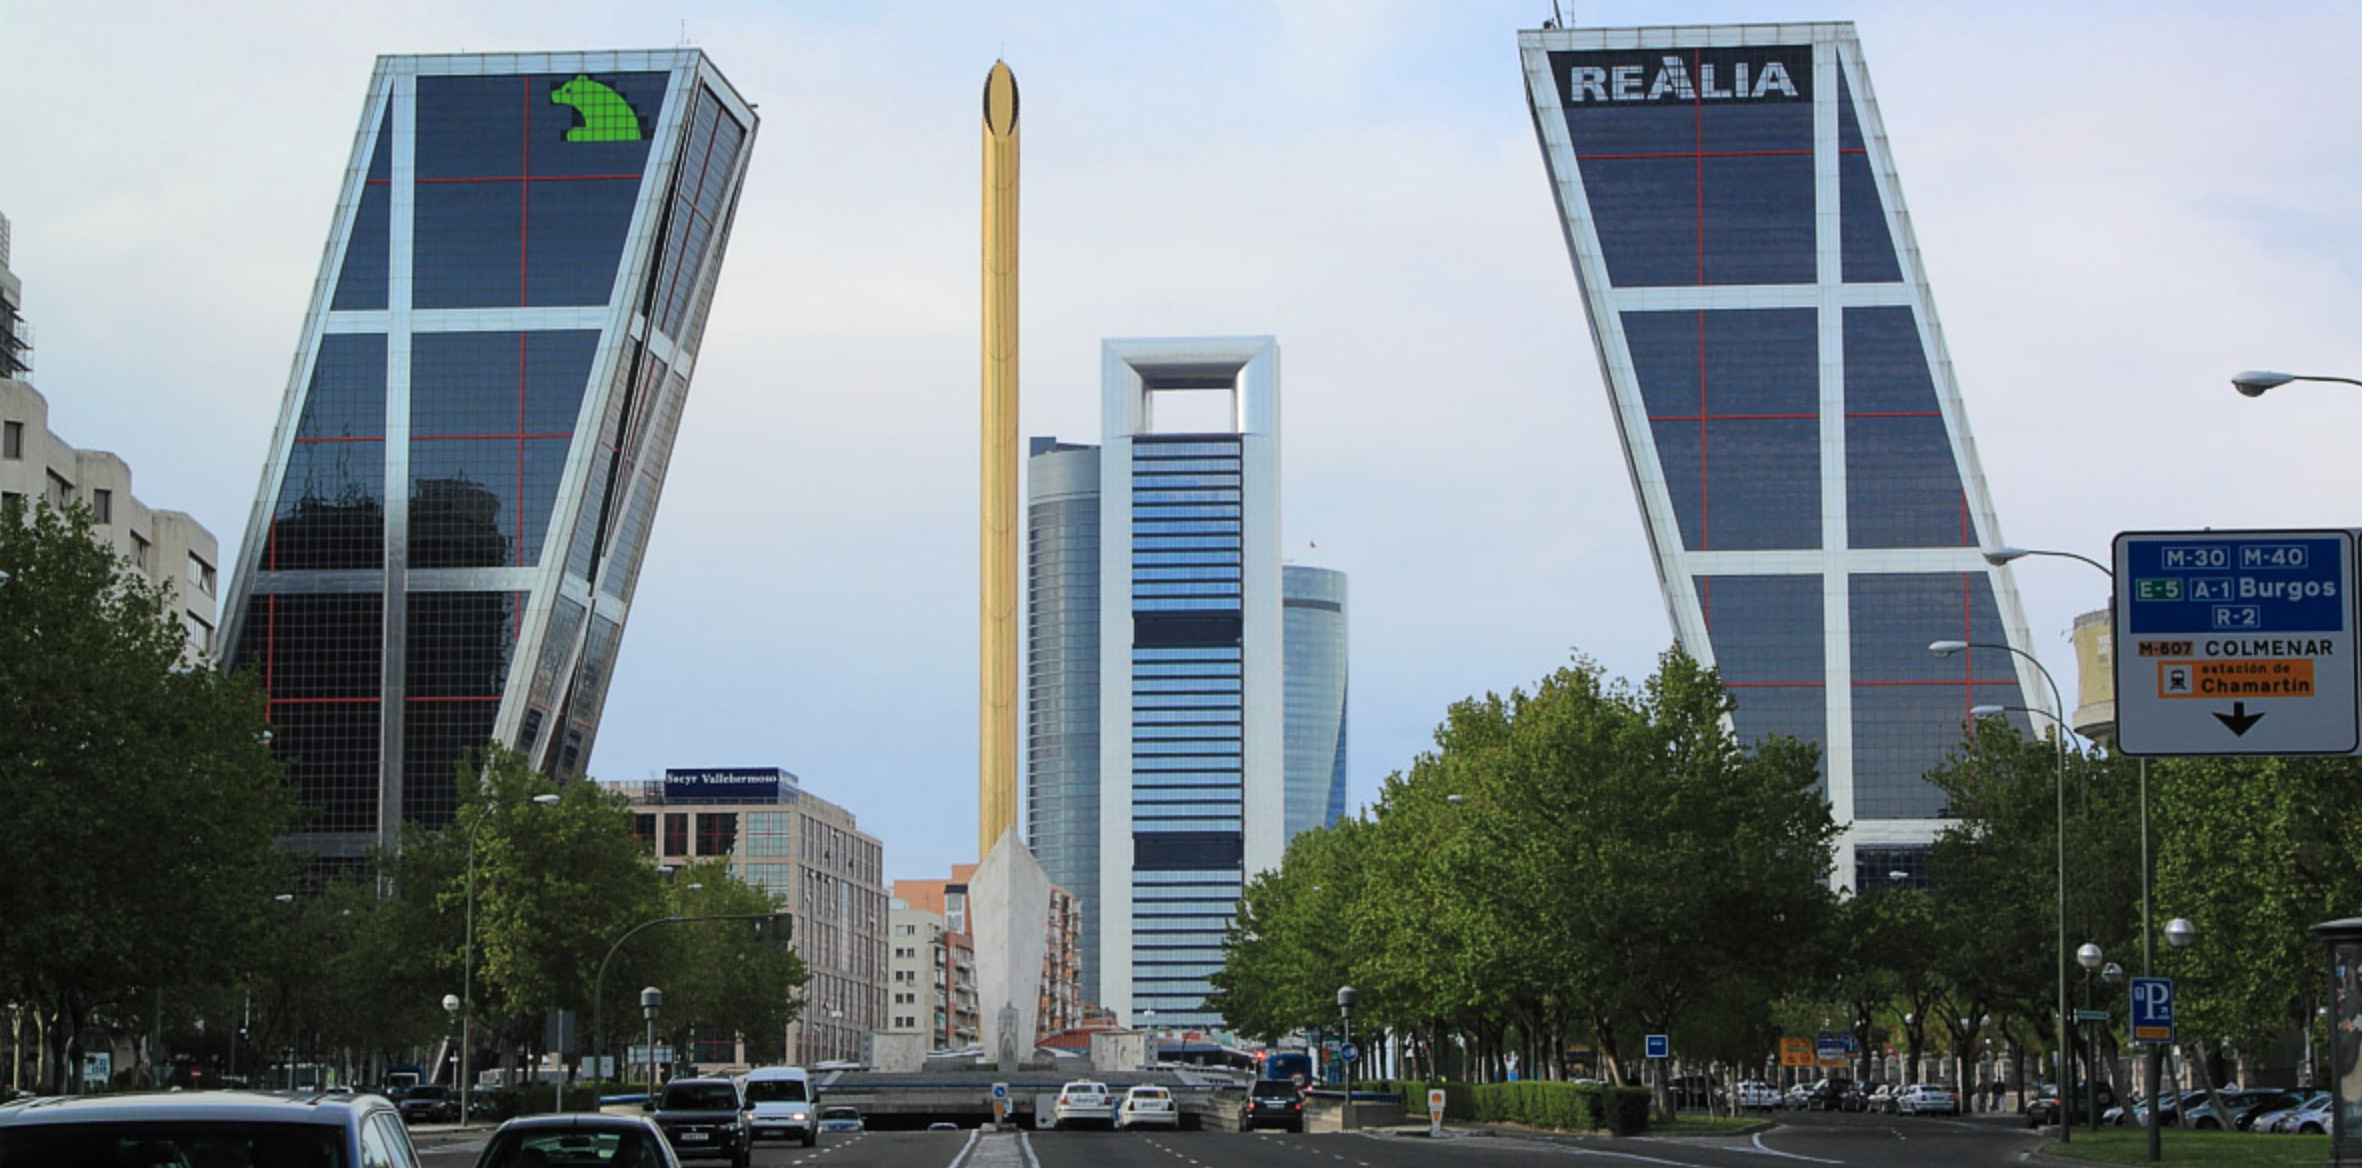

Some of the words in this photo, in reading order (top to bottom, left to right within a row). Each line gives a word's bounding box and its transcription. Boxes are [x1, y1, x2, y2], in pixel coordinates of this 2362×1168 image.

[1571, 56, 1798, 102] REALIA
[2166, 550, 2225, 566] M-30
[2244, 548, 2303, 565] M-40
[2139, 581, 2179, 598] E-5
[2195, 581, 2230, 598] A-1
[2239, 577, 2337, 601] Burgos
[2216, 608, 2256, 625] R-2
[2138, 642, 2193, 656] M-607
[2205, 640, 2334, 656] COLMENAR
[2201, 663, 2267, 674] estación
[2273, 663, 2291, 674] de
[2201, 677, 2310, 694] Chamartín
[666, 773, 698, 786] Sacyr
[2142, 982, 2169, 1020] P
